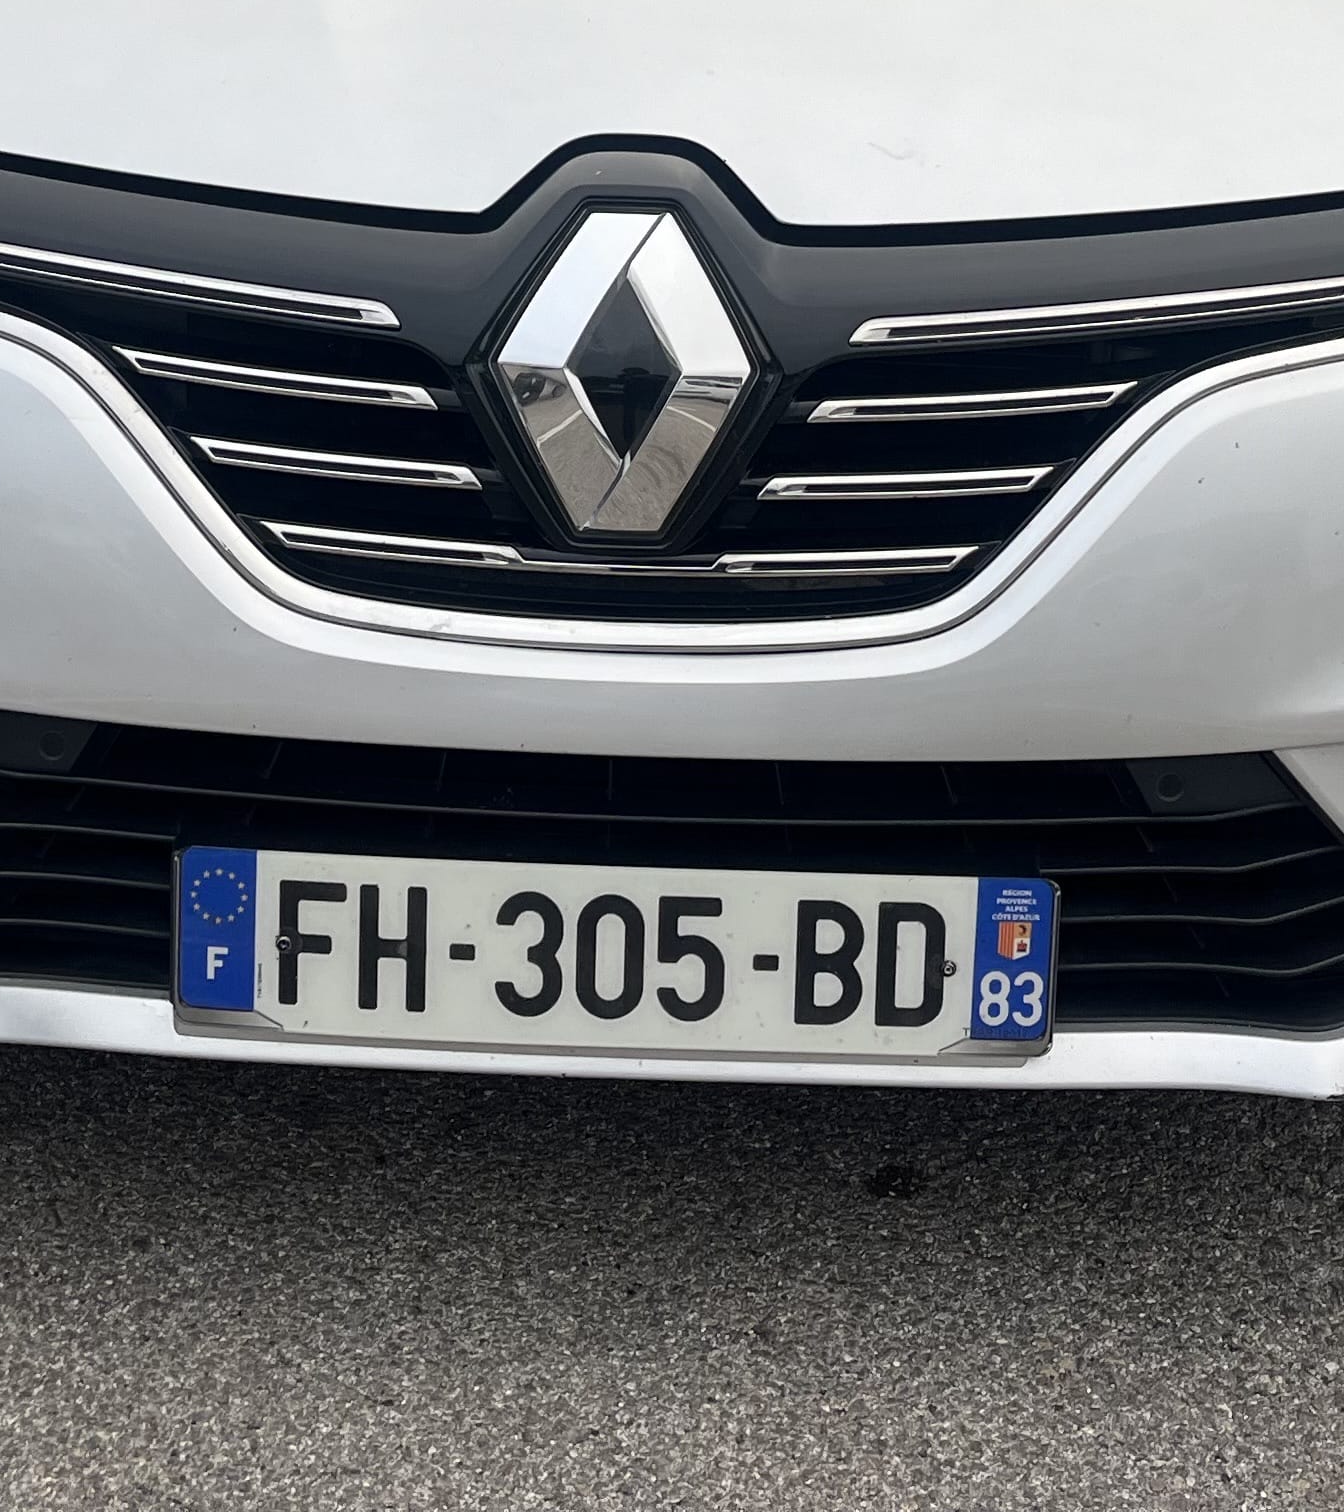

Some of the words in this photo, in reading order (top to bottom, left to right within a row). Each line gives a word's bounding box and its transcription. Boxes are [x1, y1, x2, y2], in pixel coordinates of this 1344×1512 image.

[996, 897, 1037, 906] PROVENCE
[206, 946, 229, 980] F
[278, 877, 953, 1028] FH-305-BD
[978, 970, 1044, 1027] 83
